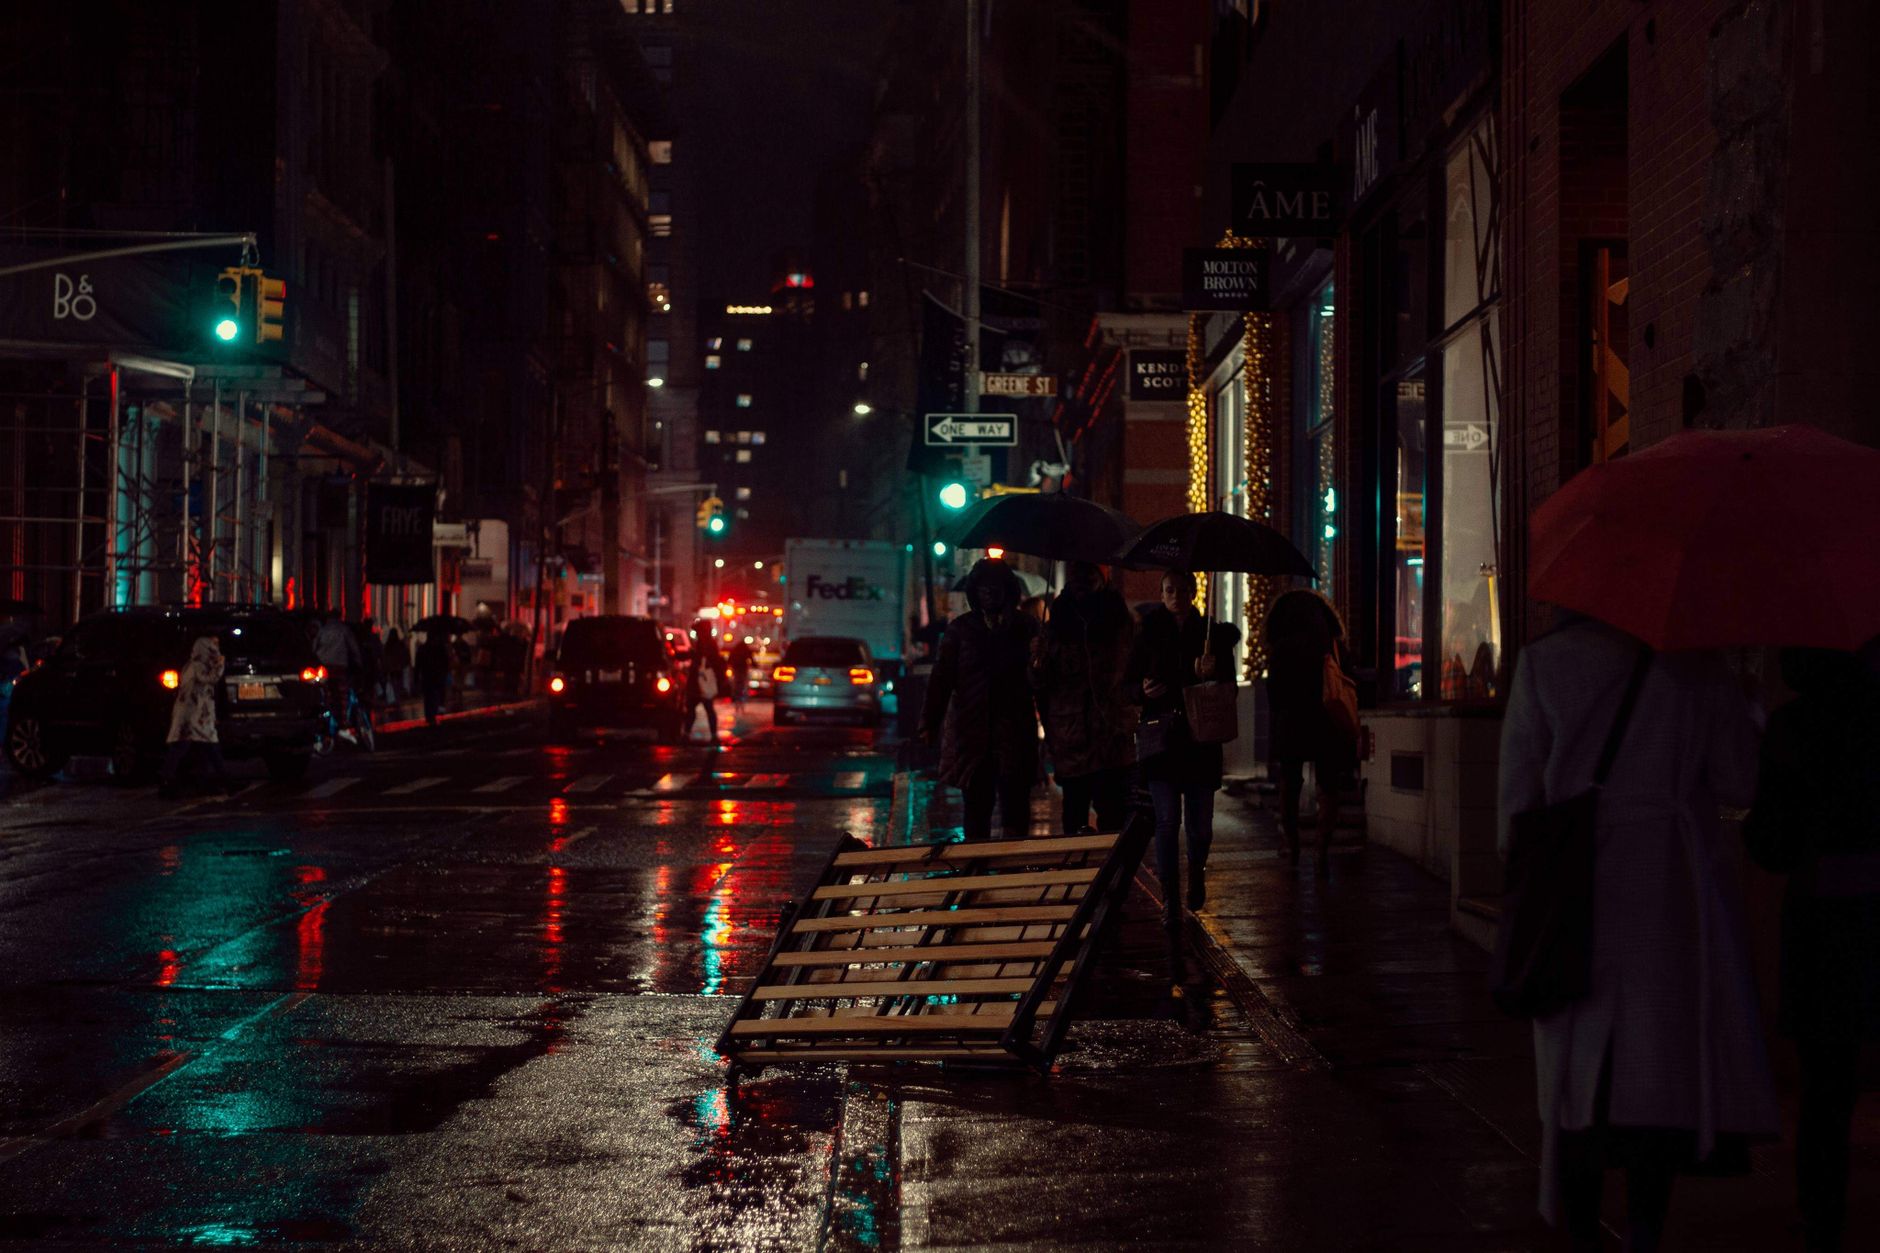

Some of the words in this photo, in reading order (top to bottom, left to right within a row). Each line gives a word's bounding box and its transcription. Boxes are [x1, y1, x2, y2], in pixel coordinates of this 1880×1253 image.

[1247, 180, 1330, 220] ÂME
[1202, 260, 1259, 274] MOLTON
[1202, 276, 1258, 291] BROWN
[1136, 362, 1187, 374] KEND
[987, 376, 1030, 393] GREENE
[1036, 376, 1051, 393] ST
[1142, 377, 1184, 388] SCOT
[940, 424, 965, 436] ONE
[977, 424, 1005, 435] WAY
[807, 575, 883, 601] FedEx
